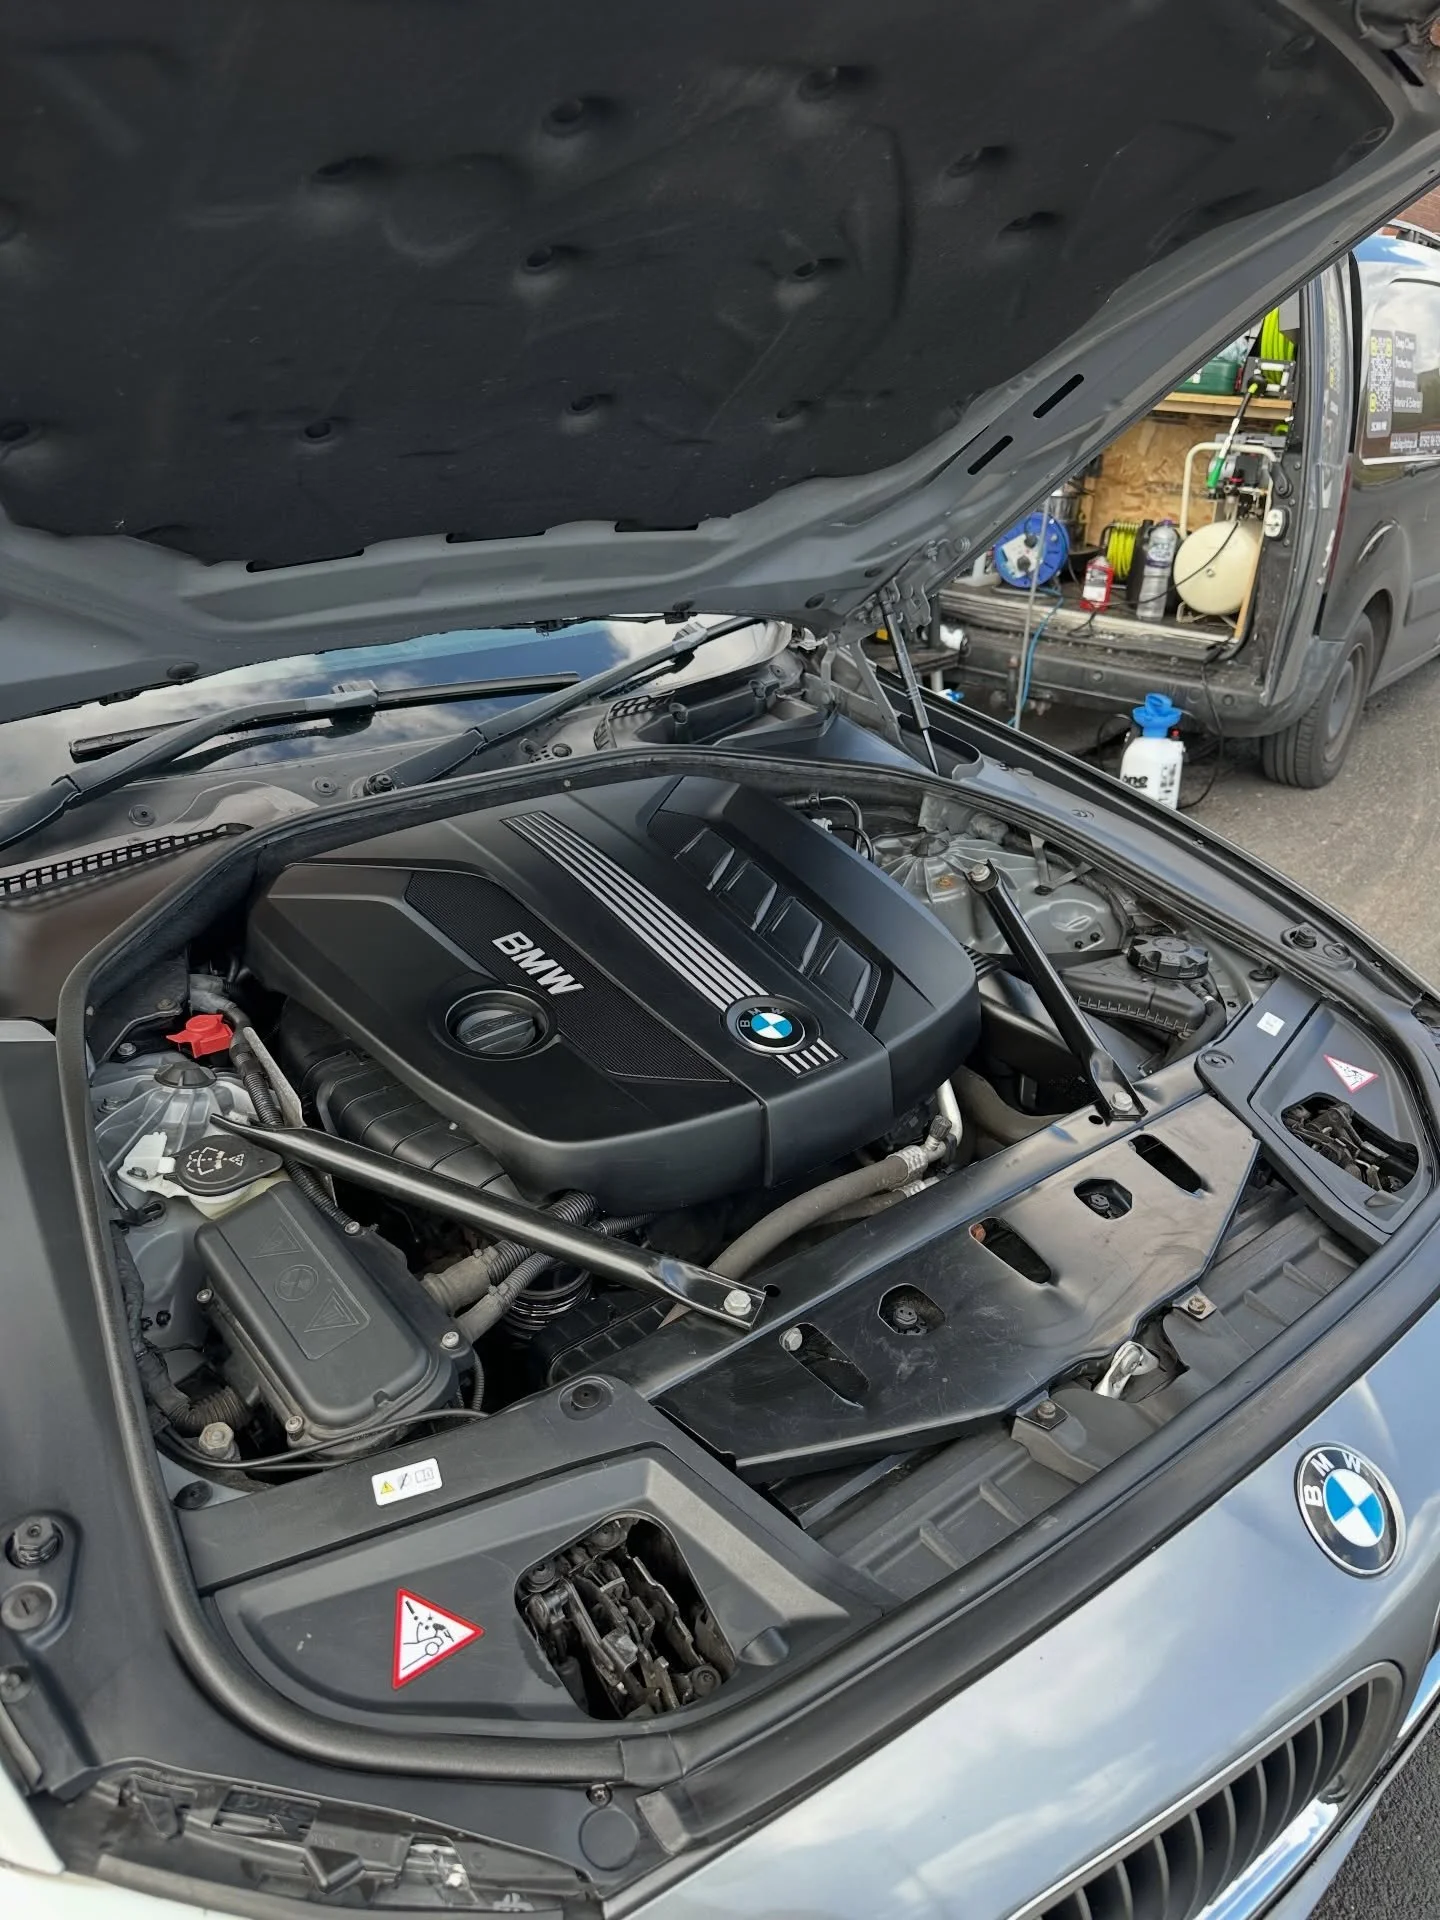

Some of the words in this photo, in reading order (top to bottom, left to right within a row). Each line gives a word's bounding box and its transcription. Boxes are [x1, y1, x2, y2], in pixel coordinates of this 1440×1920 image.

[492, 931, 584, 995] BMW
[740, 1007, 784, 1028] BMW
[1304, 1452, 1361, 1507] BMW
